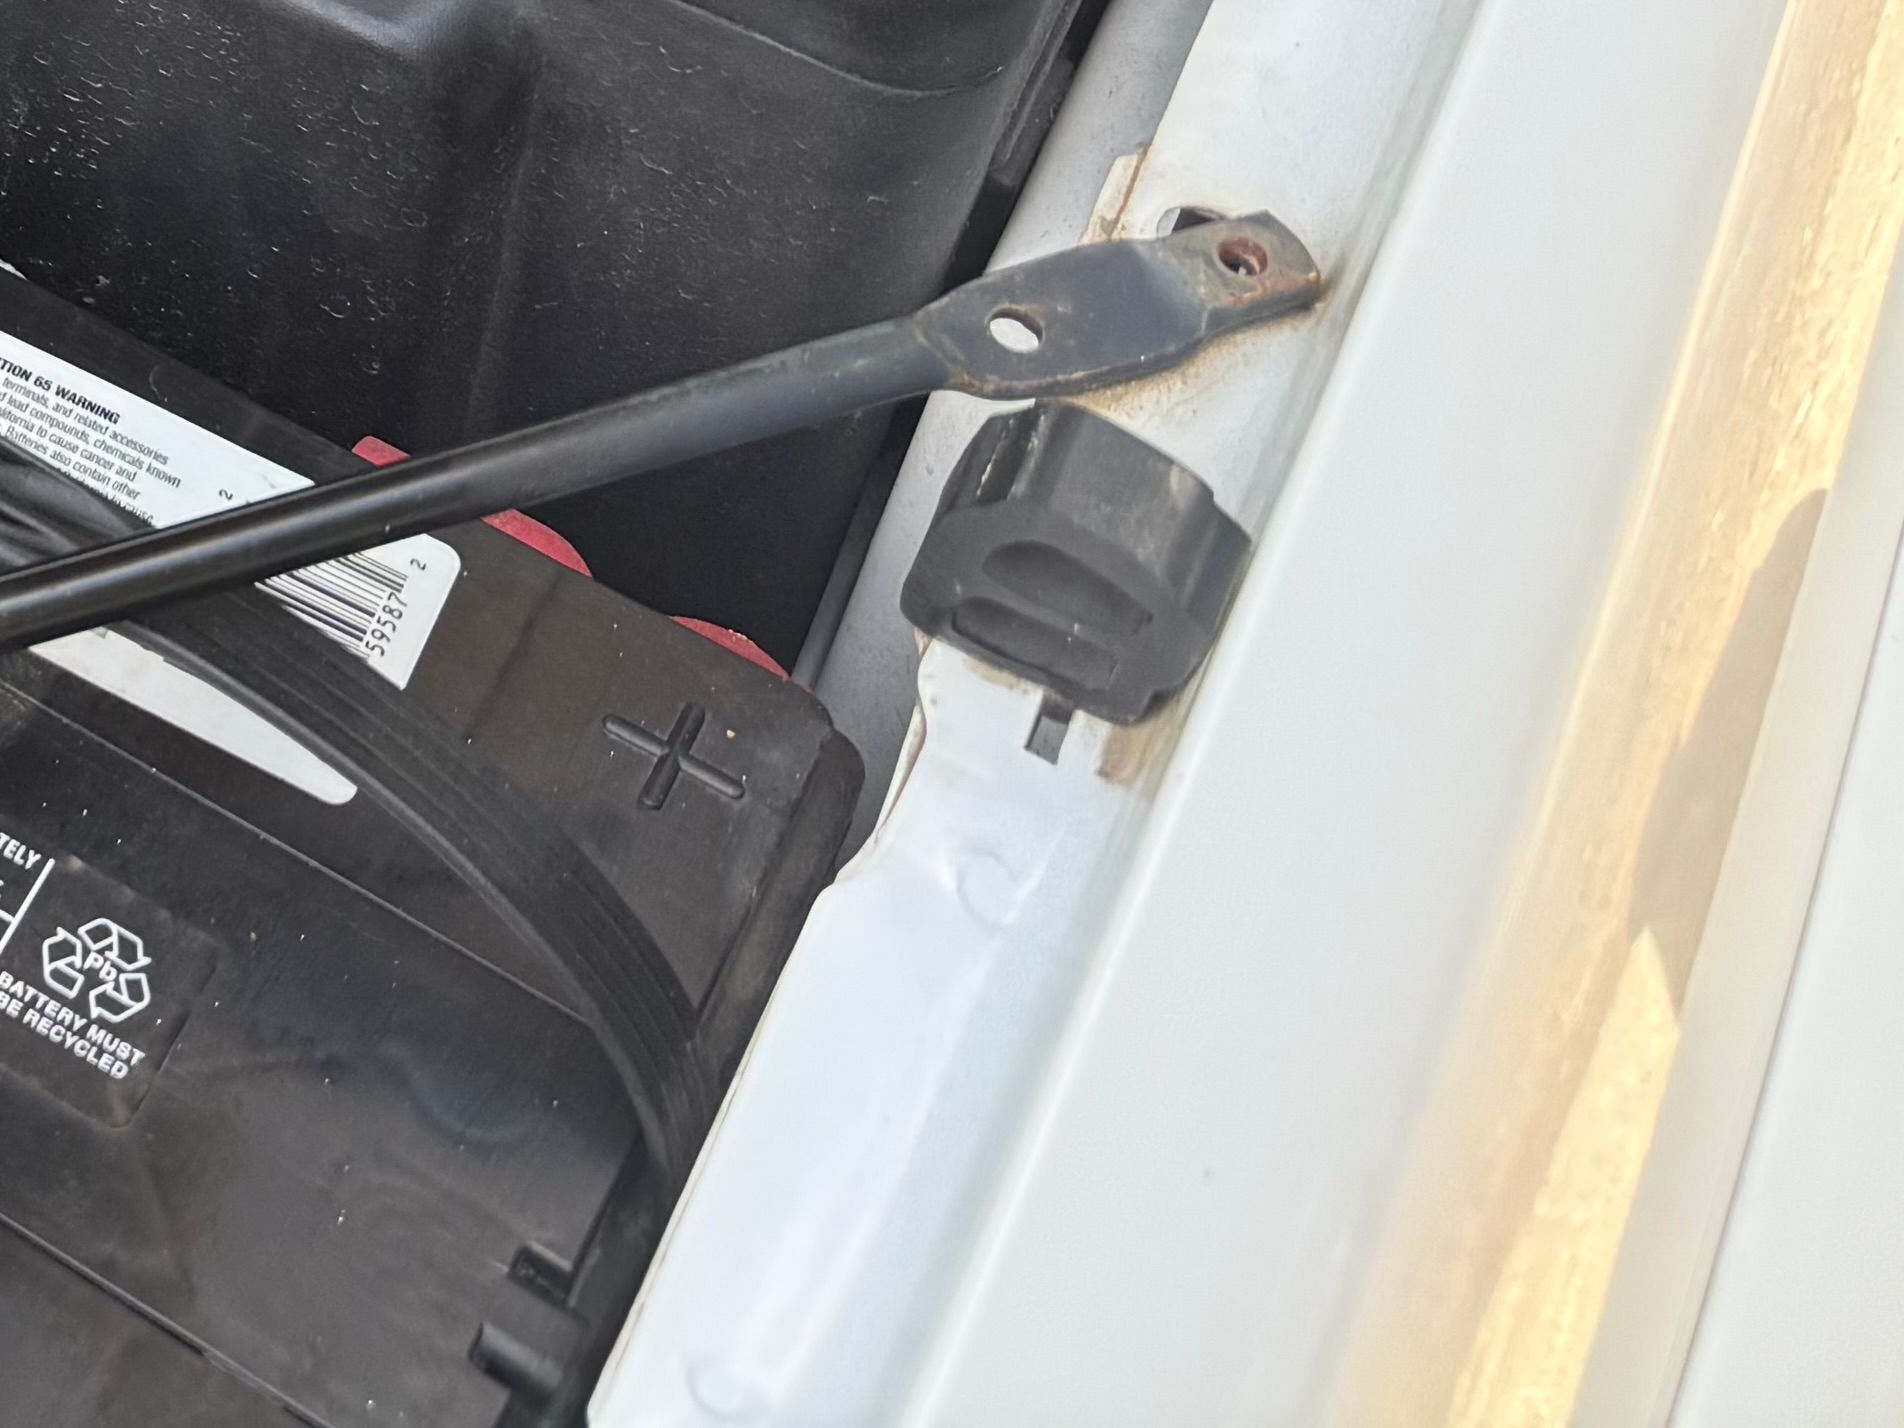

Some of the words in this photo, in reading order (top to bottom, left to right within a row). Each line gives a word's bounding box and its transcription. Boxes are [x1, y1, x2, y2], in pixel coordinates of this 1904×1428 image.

[2, 377, 50, 408] terminals,
[52, 402, 73, 418] and
[74, 411, 109, 435] related
[109, 430, 169, 465] accessories
[34, 376, 53, 391] 65
[55, 384, 120, 425] WARNING
[6, 425, 49, 455] Batteries
[50, 450, 72, 465] also
[73, 461, 111, 486] contain
[112, 480, 142, 500] other
[7, 395, 30, 413] lead
[29, 407, 91, 445] compounds,
[93, 438, 145, 470] chemicals
[145, 462, 182, 488] known
[36, 425, 48, 438] to
[48, 433, 79, 453] cause
[80, 448, 116, 470] cancer
[115, 464, 137, 482] and
[365, 590, 409, 656] 59587
[83, 951, 118, 982] Pb
[23, 1009, 129, 1079] RECYCLED
[86, 1024, 146, 1067] MUST
